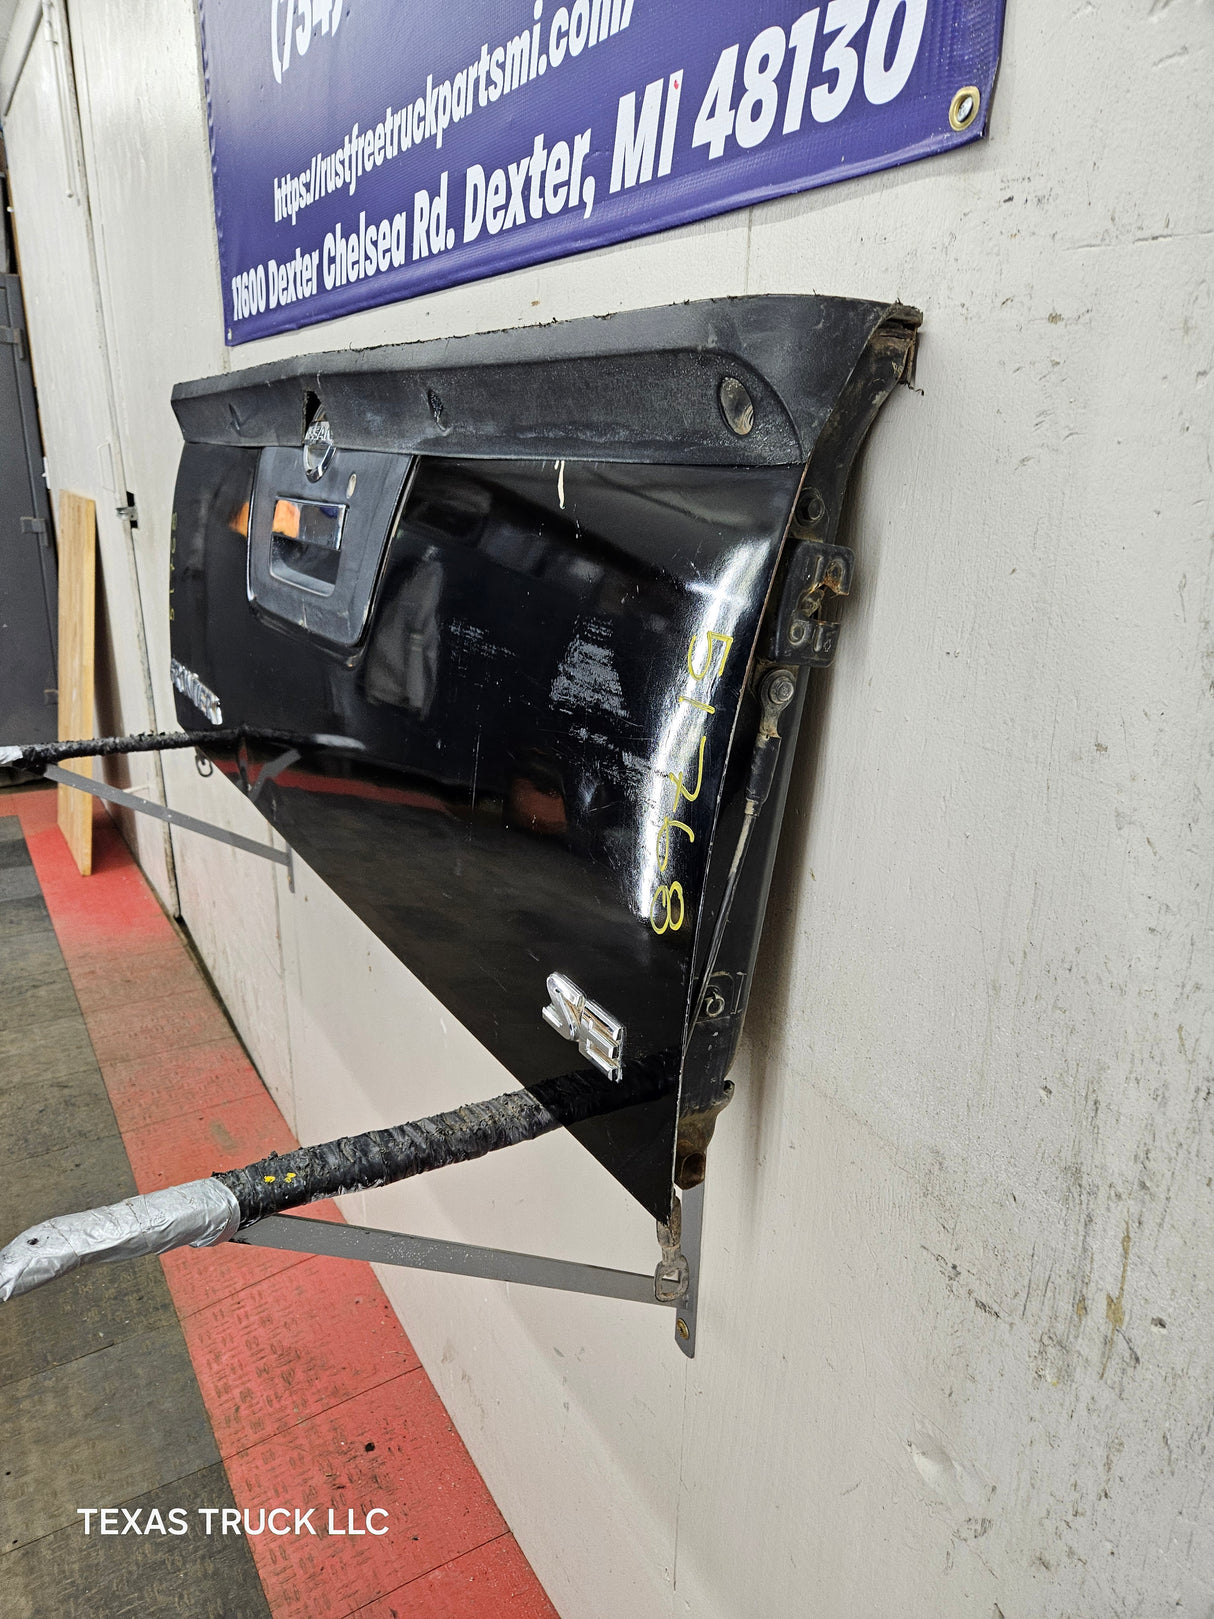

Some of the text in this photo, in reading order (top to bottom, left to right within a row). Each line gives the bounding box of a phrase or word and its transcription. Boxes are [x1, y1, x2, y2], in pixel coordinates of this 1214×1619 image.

[231, 0, 928, 321] 11600 Dexter Chelsea Rd. Dexter, MI 48130
[650, 631, 733, 934] 51768
[542, 972, 627, 1083] SE
